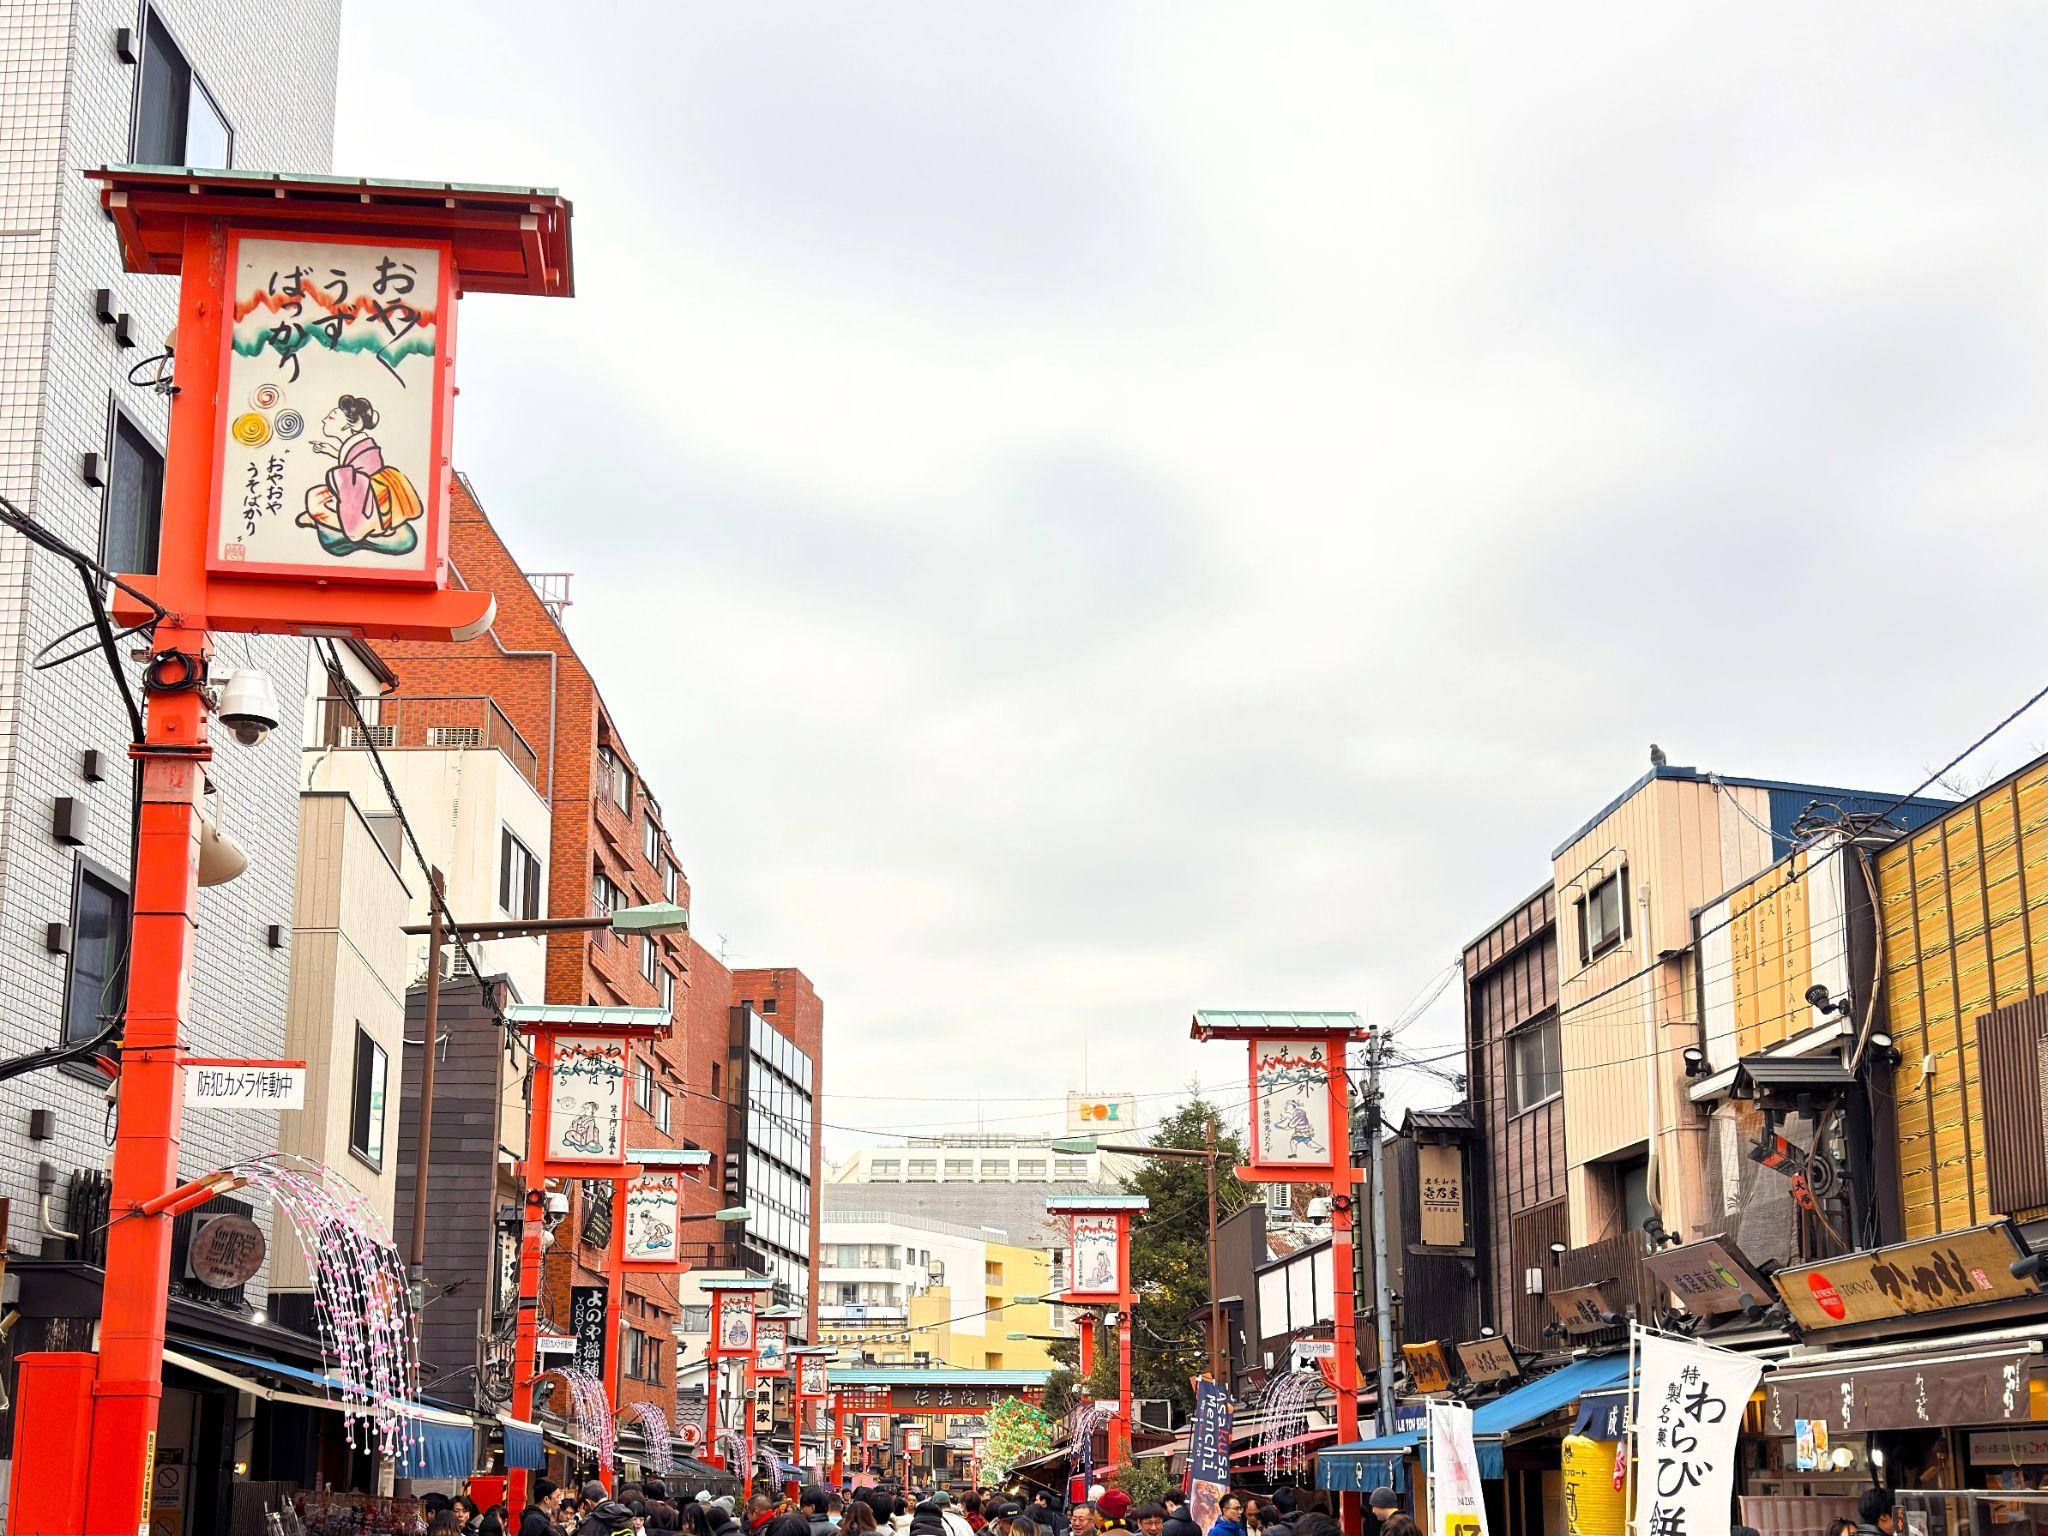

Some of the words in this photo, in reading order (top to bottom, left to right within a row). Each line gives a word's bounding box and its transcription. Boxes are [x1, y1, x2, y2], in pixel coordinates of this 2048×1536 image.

[243, 462, 262, 536] うそばかり
[266, 455, 286, 515] おやおや
[197, 1070, 293, 1099] 防犯カメラ作動中
[1081, 1103, 1120, 1121] ROX
[574, 1296, 585, 1339] YONOYA
[1840, 1280, 1874, 1297] TOKYO
[756, 1376, 771, 1423] 大黒家
[1656, 1365, 1701, 1447] 特製名菓
[1201, 1394, 1217, 1471] Menchi
[1216, 1391, 1228, 1479] Asakusa
[1649, 1381, 1727, 1536] わらび餅
